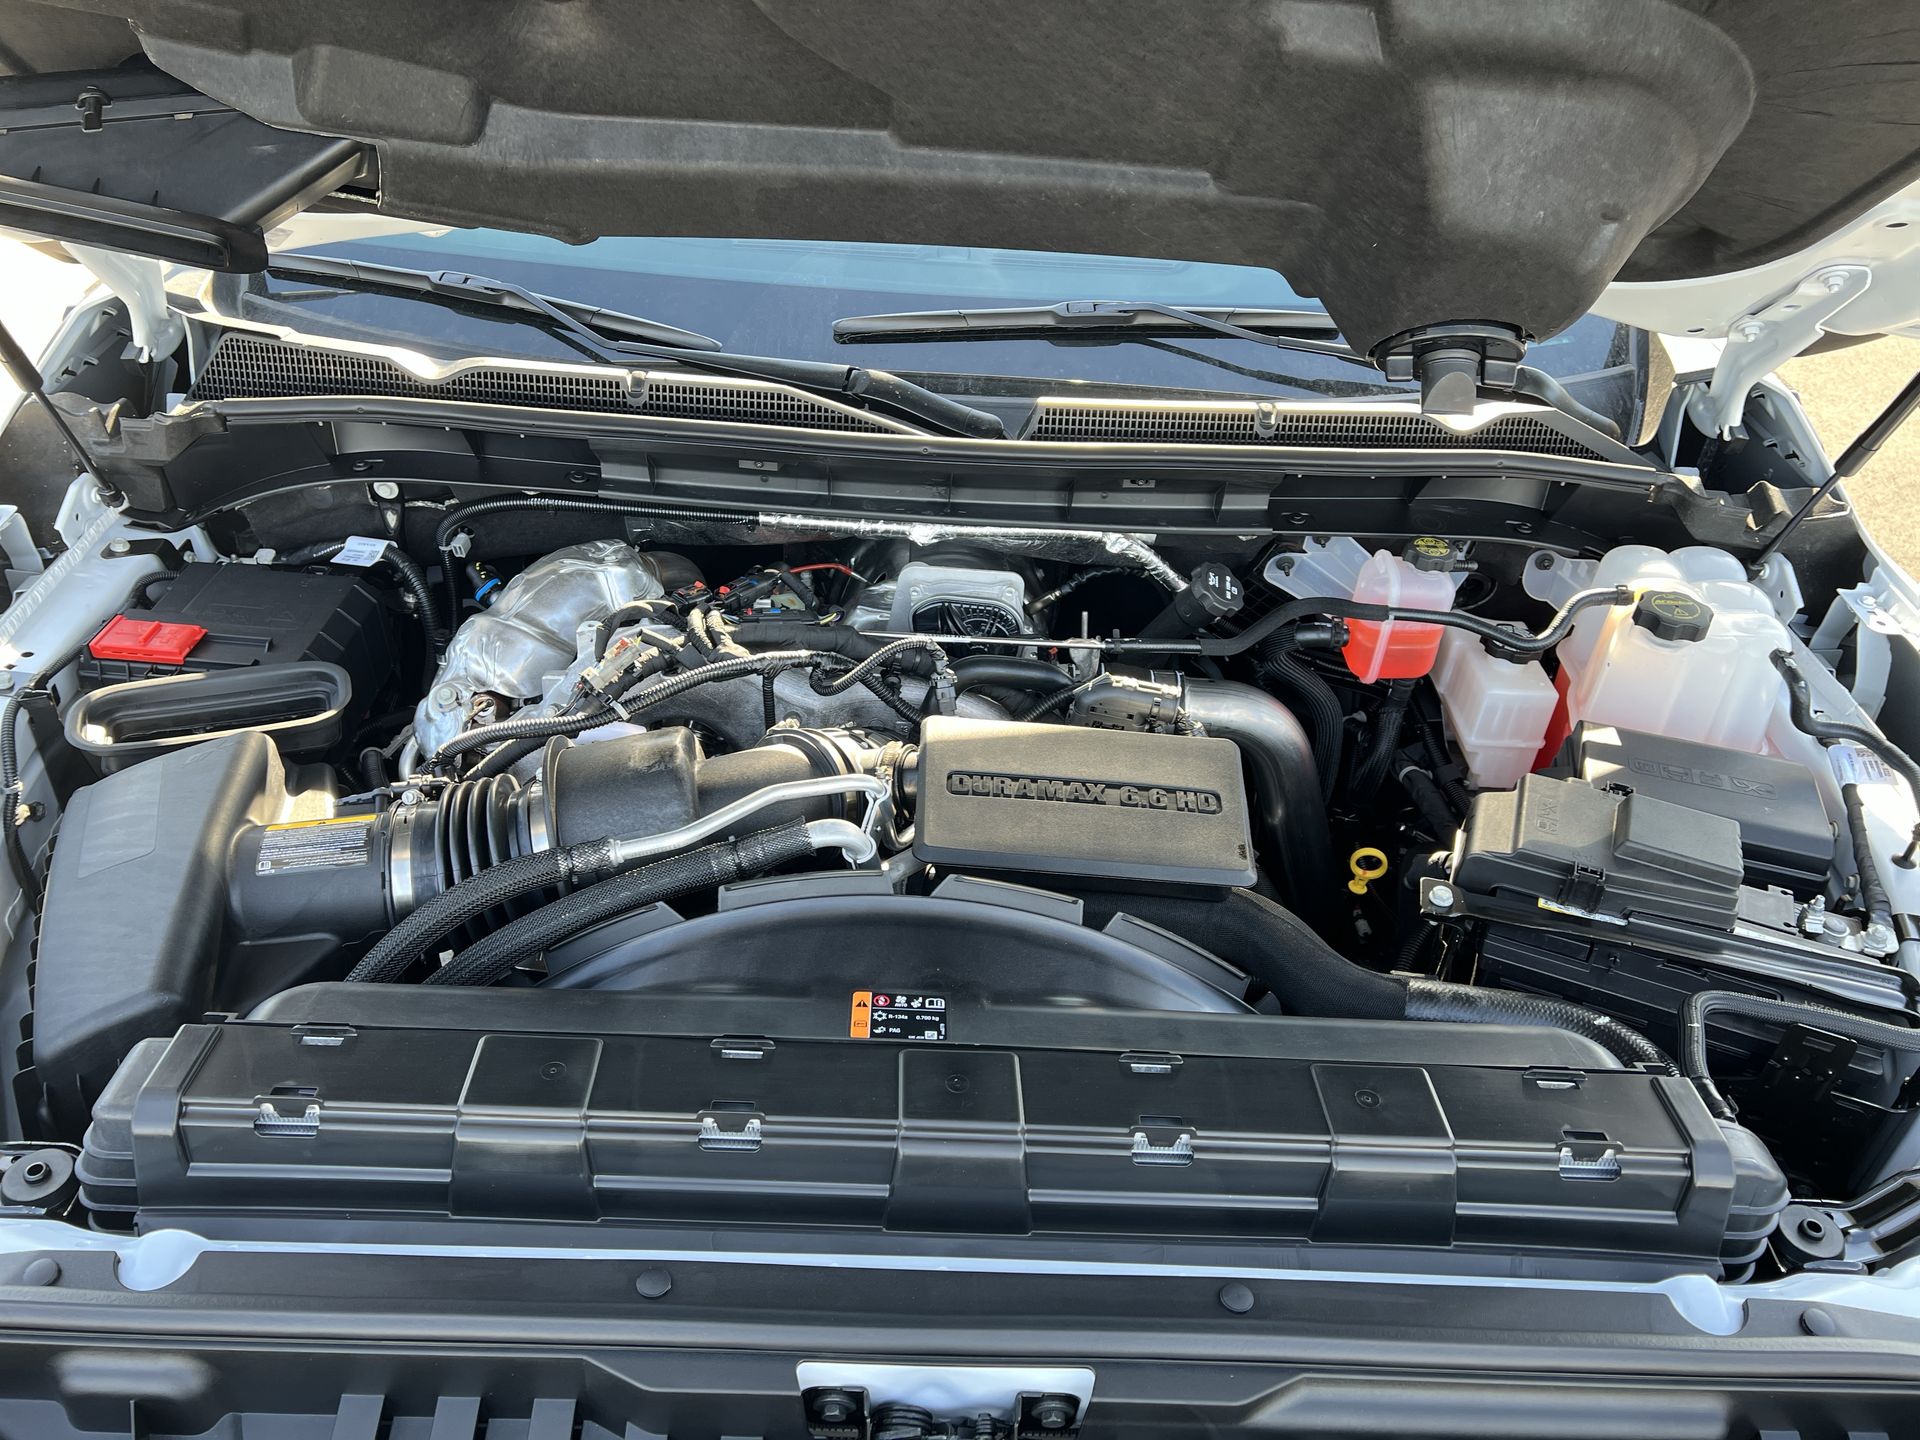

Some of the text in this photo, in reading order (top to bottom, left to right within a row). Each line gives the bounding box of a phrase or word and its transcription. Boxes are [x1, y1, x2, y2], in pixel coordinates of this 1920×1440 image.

[951, 773, 1219, 815] DURAMAX 6.6 HD
